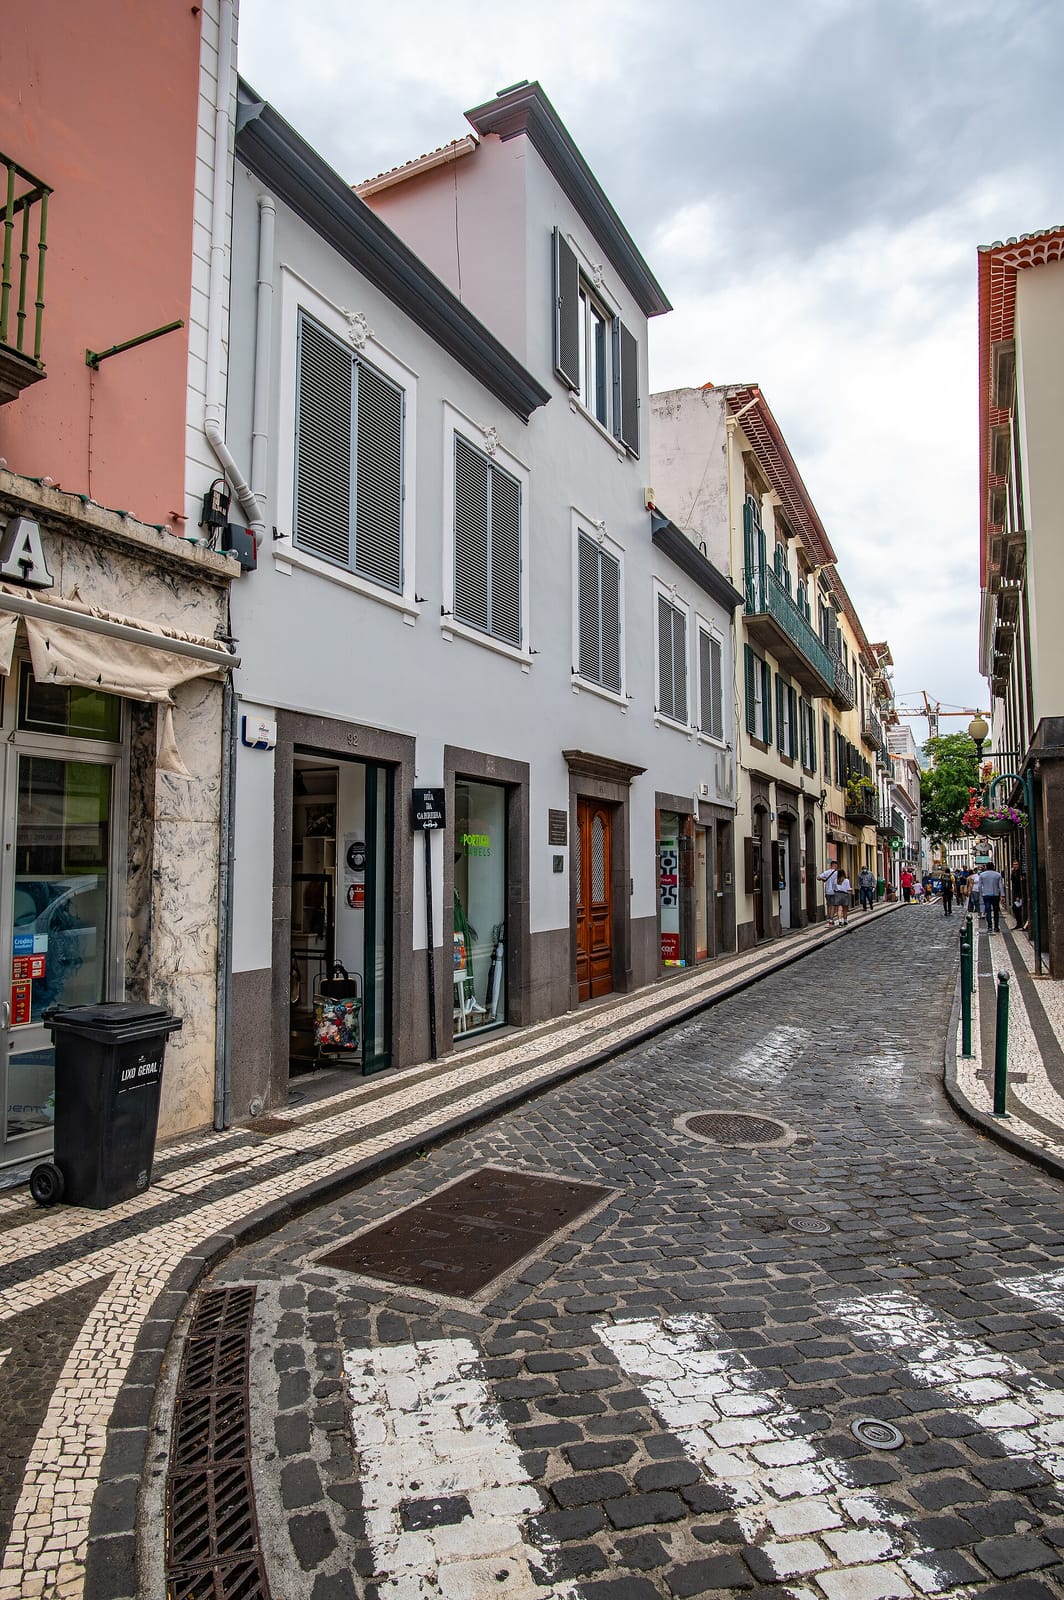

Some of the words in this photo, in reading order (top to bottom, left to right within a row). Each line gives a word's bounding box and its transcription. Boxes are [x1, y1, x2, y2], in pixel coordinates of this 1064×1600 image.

[0, 516, 54, 588] A
[346, 732, 359, 747] 92
[425, 802, 433, 810] DA
[121, 1067, 137, 1082] LIXO
[137, 1061, 158, 1077] GERAL
